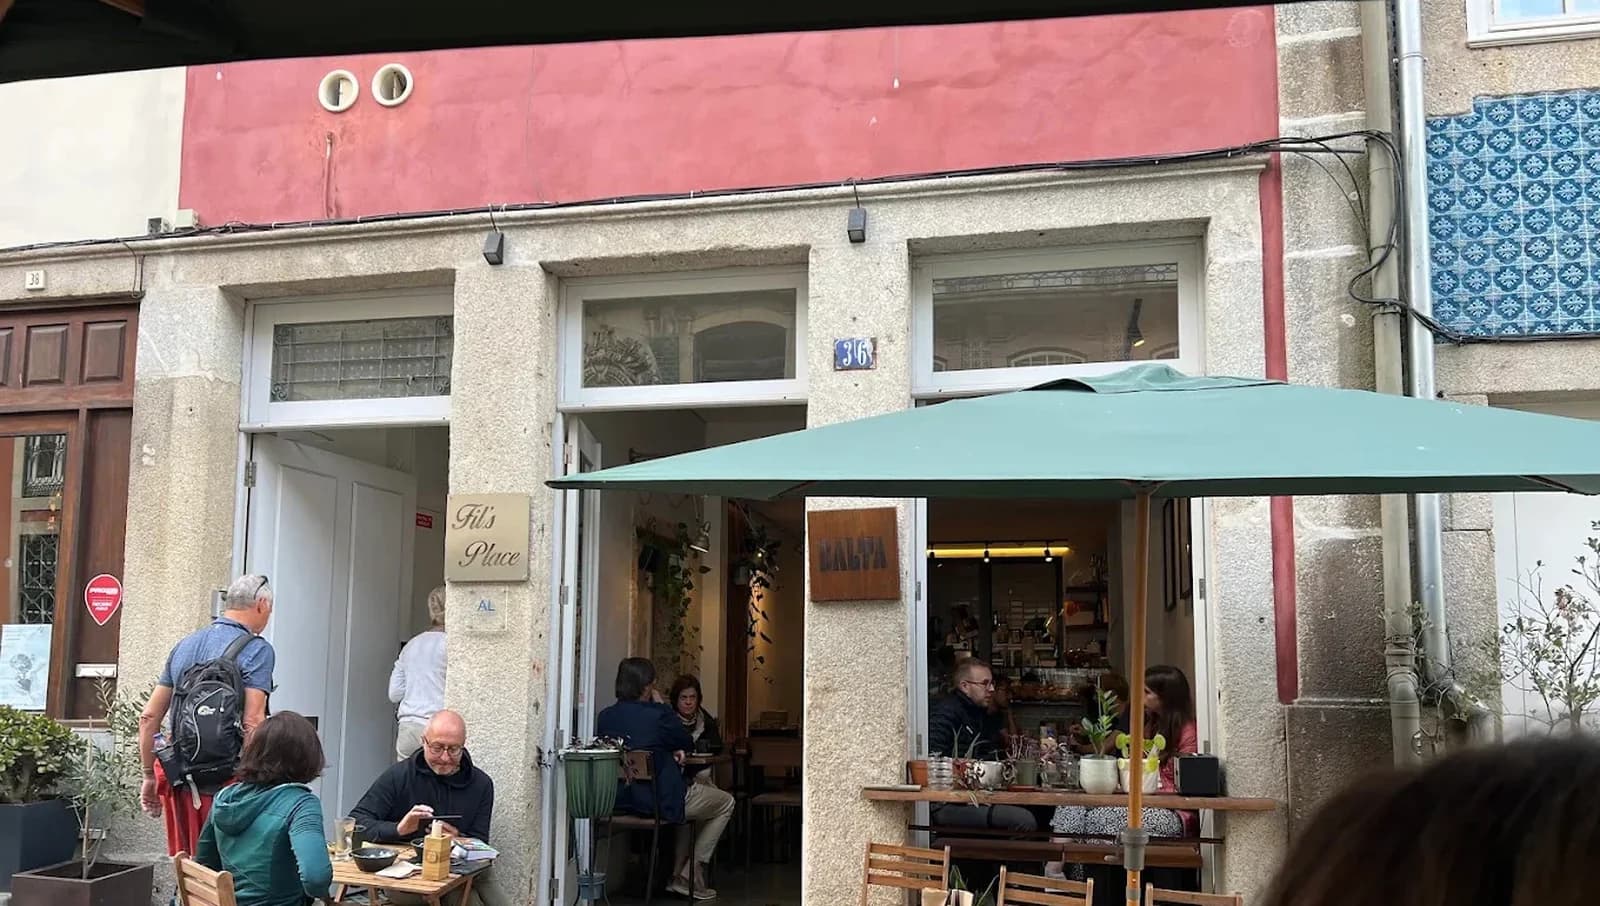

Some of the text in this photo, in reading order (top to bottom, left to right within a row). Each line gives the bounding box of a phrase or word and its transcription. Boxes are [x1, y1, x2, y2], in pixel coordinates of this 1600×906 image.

[29, 272, 40, 286] 38
[842, 341, 868, 366] 36
[451, 503, 496, 530] Fil's
[458, 540, 521, 568] Place
[477, 600, 496, 612] AL
